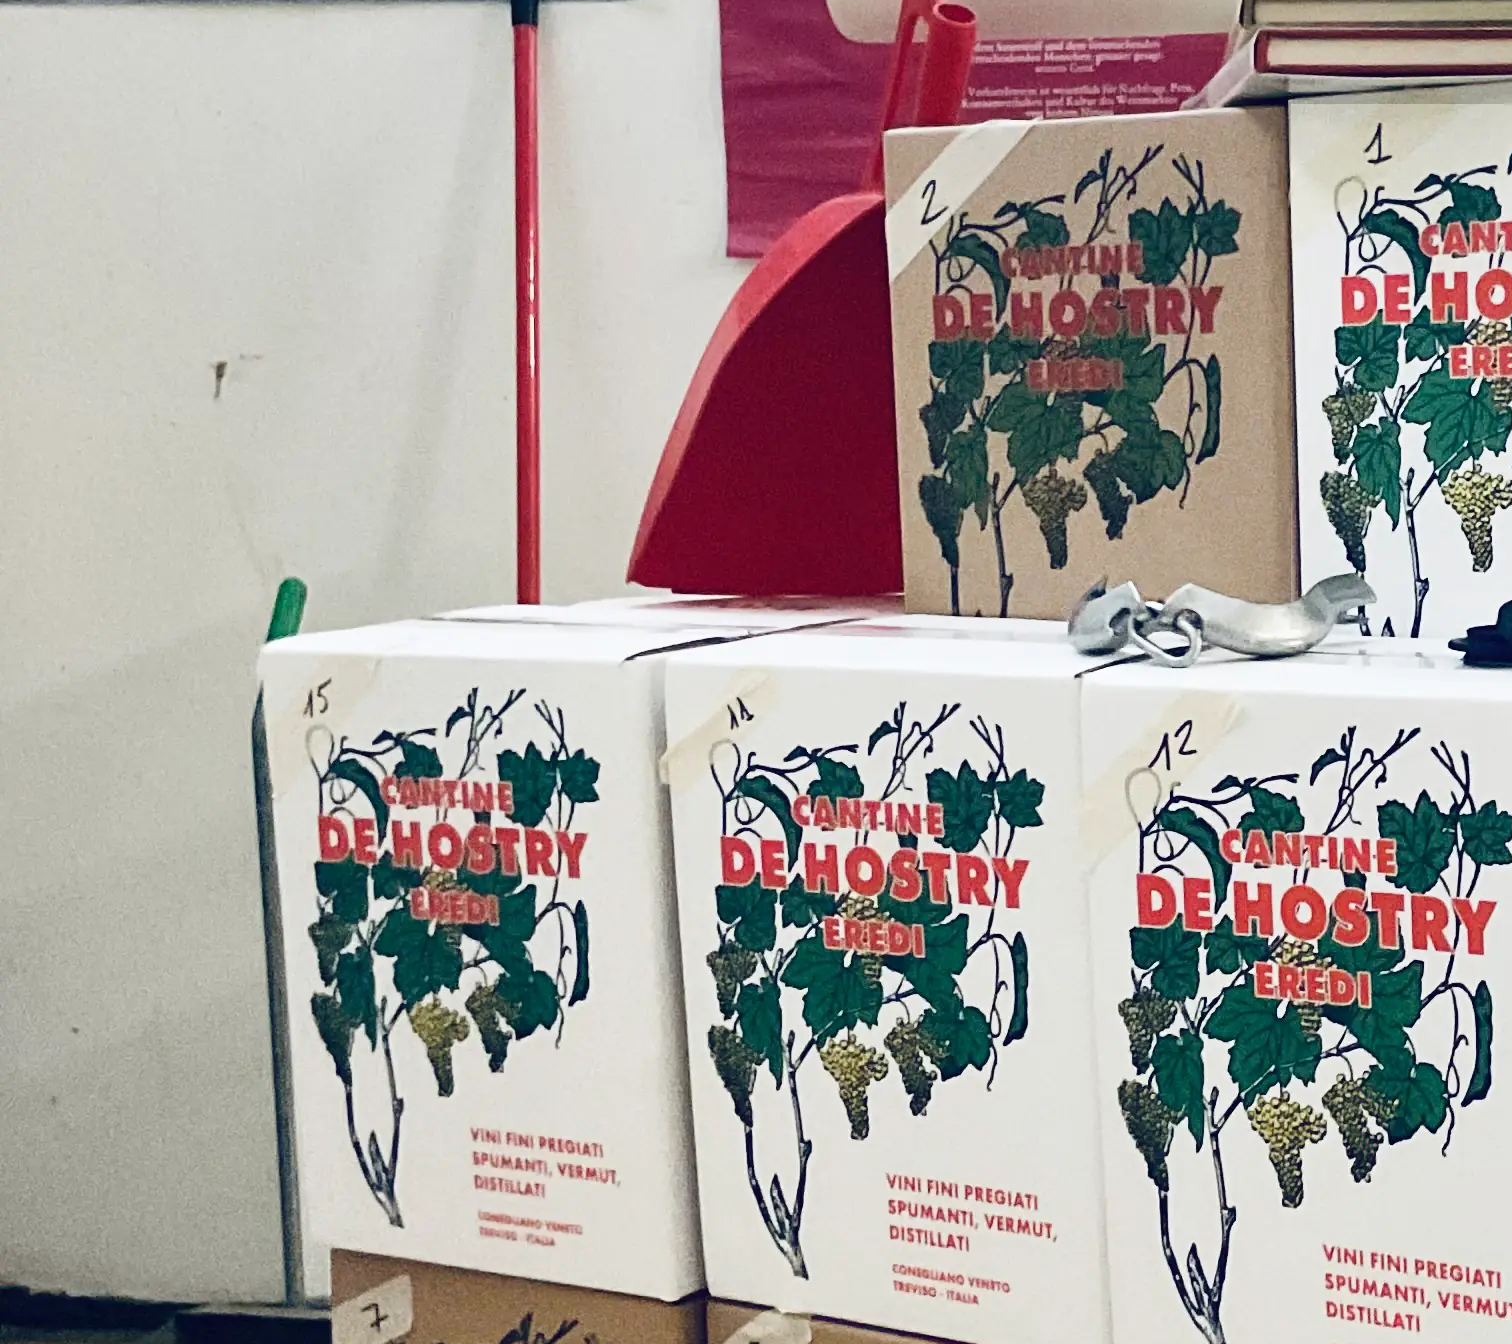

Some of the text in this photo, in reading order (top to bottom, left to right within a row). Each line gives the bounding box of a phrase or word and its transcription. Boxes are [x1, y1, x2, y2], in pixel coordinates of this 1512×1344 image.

[1364, 122, 1392, 164] 1
[921, 179, 949, 226] 2
[1002, 241, 1144, 279] CANTINE
[932, 285, 1224, 342] DE HOSTRY
[1341, 272, 1413, 326] DE
[303, 677, 332, 718] 15
[1148, 719, 1198, 771] 12
[380, 775, 513, 814] CANTINE
[790, 794, 945, 838] CANTINE
[318, 815, 589, 879] DE HOSTRY
[1218, 828, 1398, 877] CANTINE
[720, 834, 1031, 910] DE HOSTRY
[410, 887, 500, 926] EREDI
[1136, 872, 1498, 956] DE HOSTRY
[823, 915, 927, 959] EREDI
[1253, 960, 1373, 1009] EREDI
[470, 1127, 604, 1158] VINI FINI PREGIATI
[472, 1151, 621, 1187] SPUMANTI, VERMUT,
[474, 1174, 546, 1198] DISTILLATI
[885, 1172, 1039, 1211] VINI FINI PREGIATI
[888, 1199, 1058, 1243] SPUMANTI, VERMUT,
[889, 1224, 970, 1252] DISTILLATI
[1322, 1243, 1502, 1289] VINI FINI PREGIATI
[893, 1279, 979, 1305] TREVISO ITALIA
[1325, 1272, 1431, 1310] SPUMANTI,
[361, 1302, 389, 1333] 7
[1326, 1300, 1421, 1333] DISTILLATI
